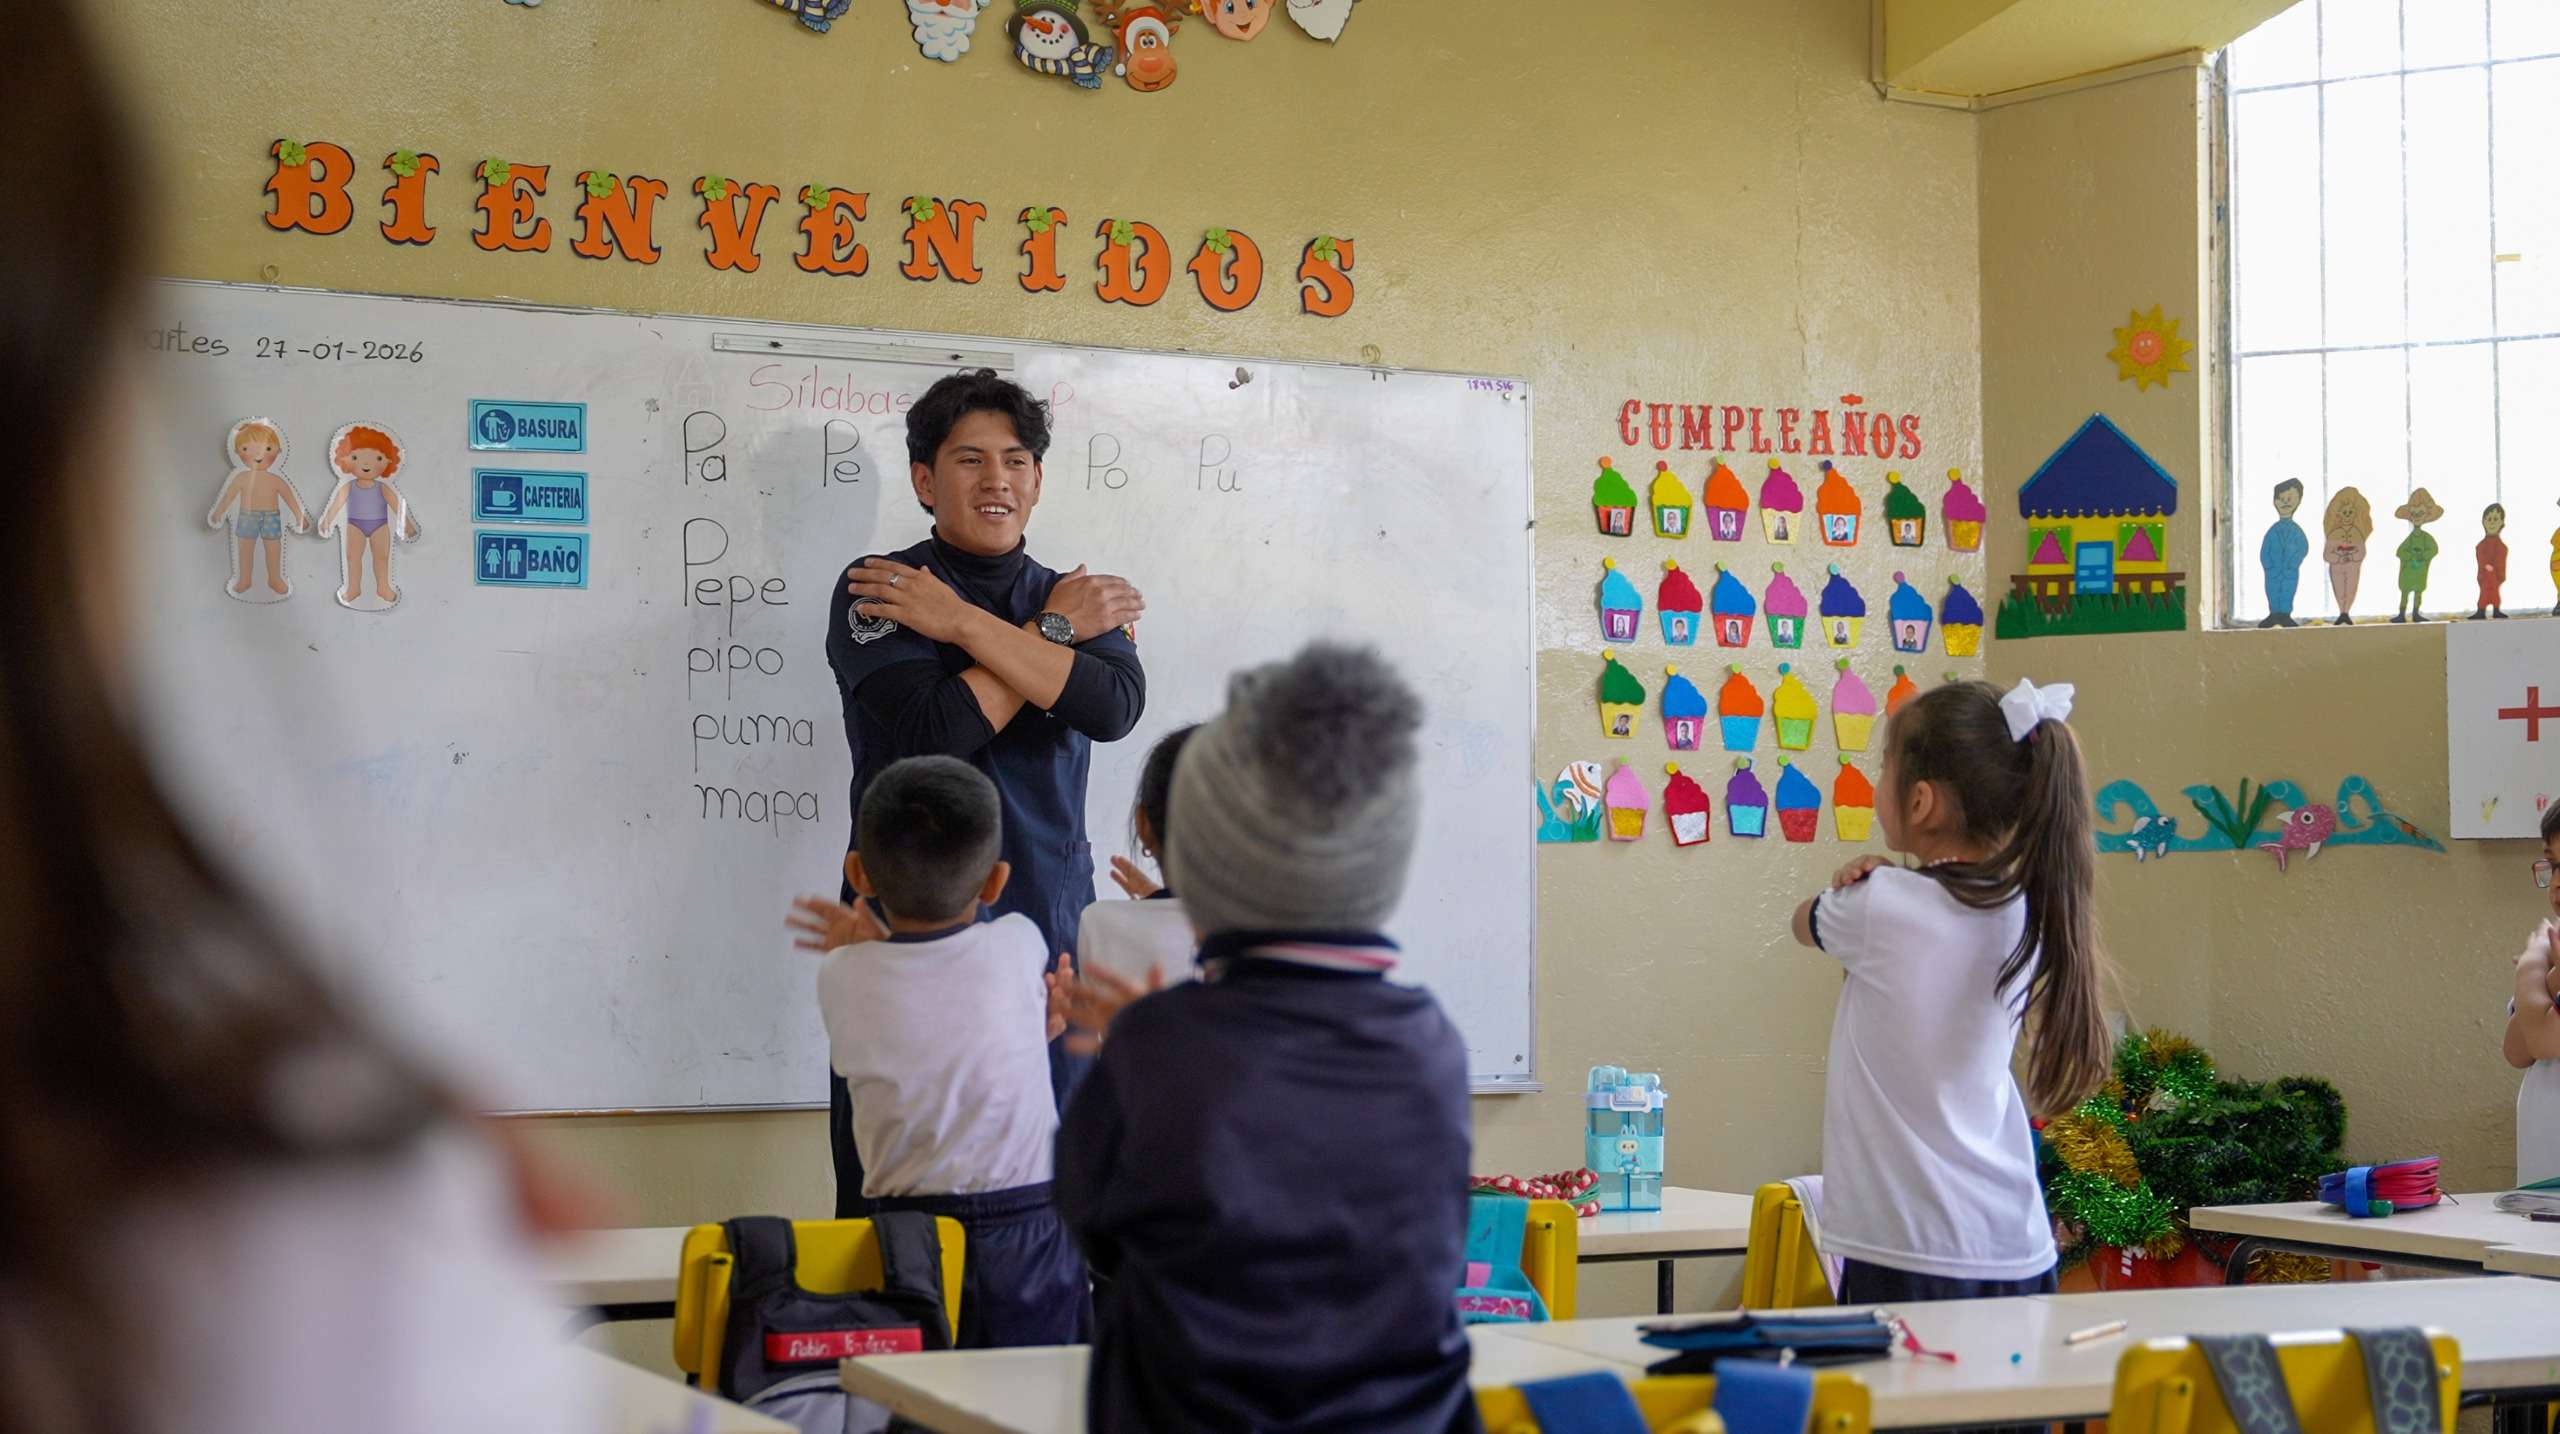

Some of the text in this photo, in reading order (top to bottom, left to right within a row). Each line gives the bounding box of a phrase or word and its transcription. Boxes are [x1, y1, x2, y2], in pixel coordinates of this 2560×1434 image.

[263, 139, 1355, 317] BIENVENIDOS
[143, 320, 230, 357] artes
[747, 363, 914, 415] Sílabas
[517, 417, 578, 440] BASURA
[683, 410, 1242, 493] Pa Pe Po Pu
[1616, 393, 1923, 460] CUMPLEAÑOS
[523, 485, 582, 510] CAFETERIA
[527, 545, 580, 573] BAÑO
[683, 517, 789, 638] Pepe
[687, 636, 784, 701] pipo
[692, 713, 813, 774] puma
[693, 783, 820, 838] mapa
